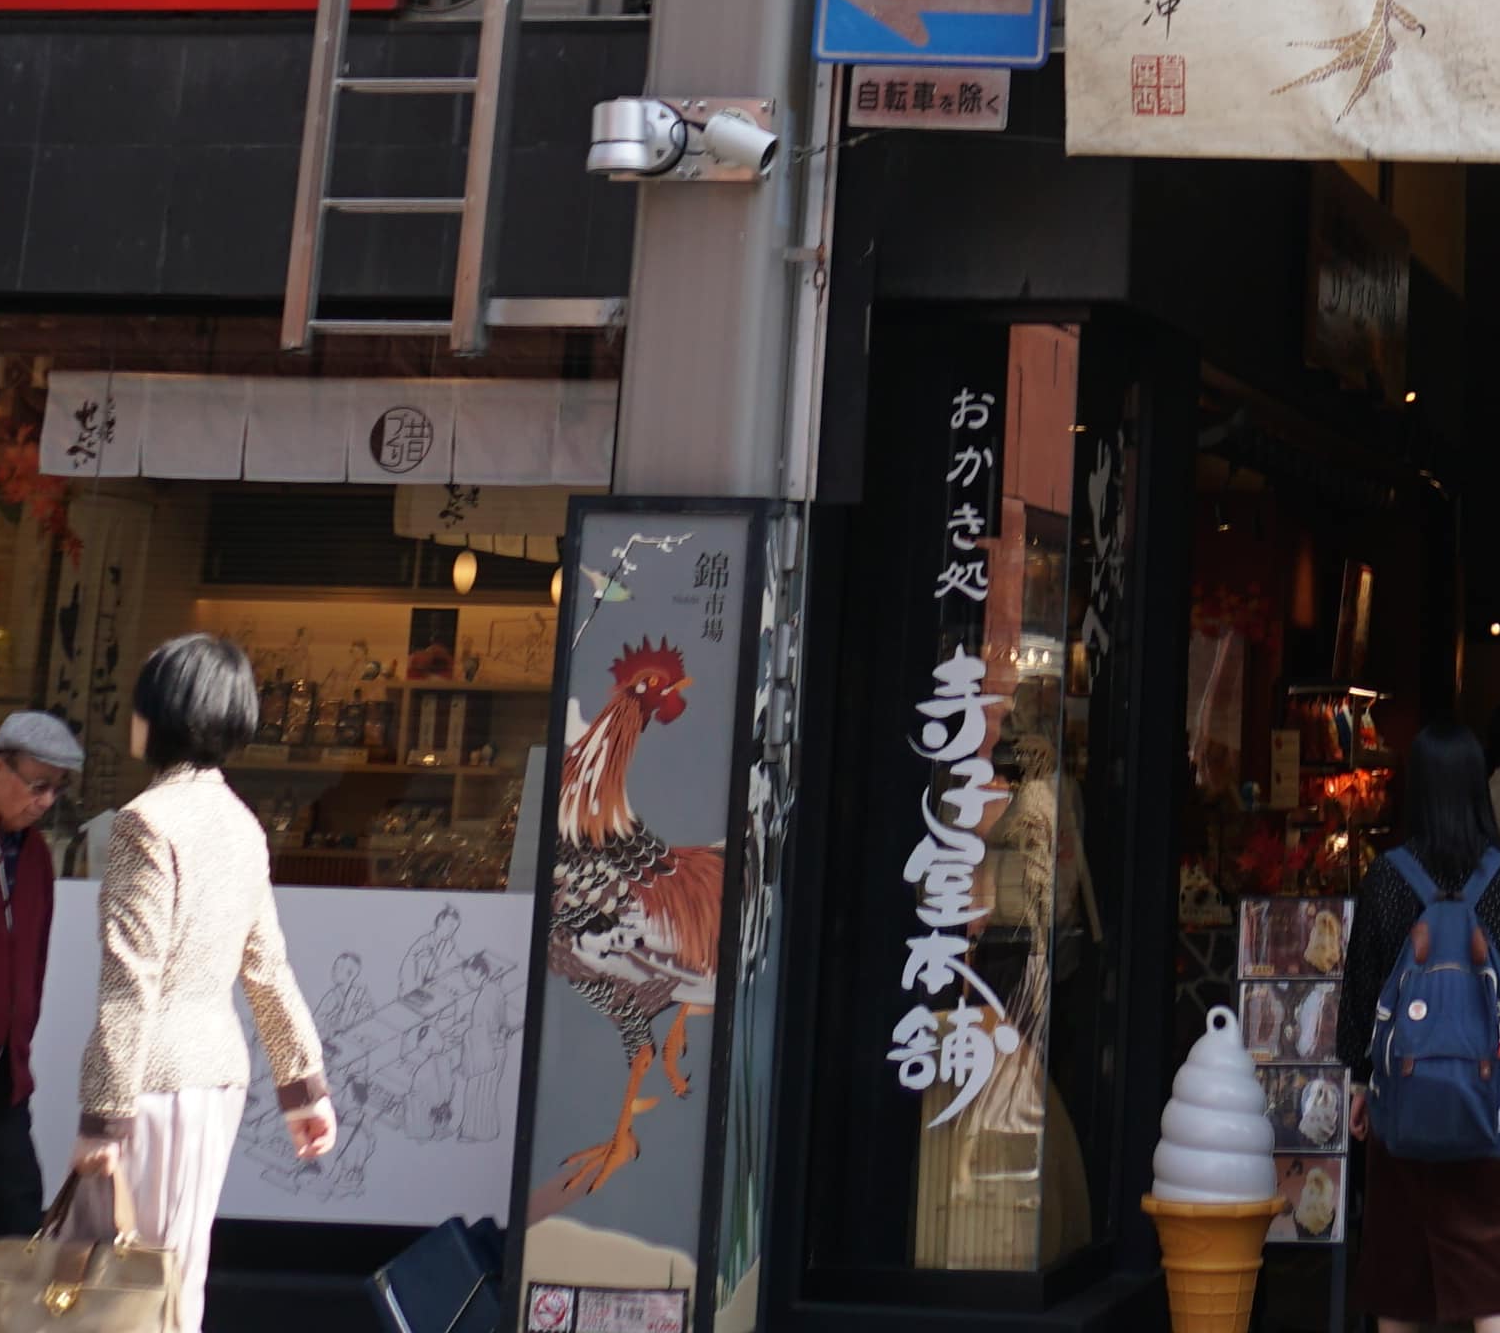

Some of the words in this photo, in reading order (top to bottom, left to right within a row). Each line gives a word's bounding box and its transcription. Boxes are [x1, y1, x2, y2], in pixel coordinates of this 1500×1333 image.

[855, 77, 1001, 117] 自転車を除く
[933, 386, 998, 602] おかき処
[692, 549, 730, 644] 錦市場
